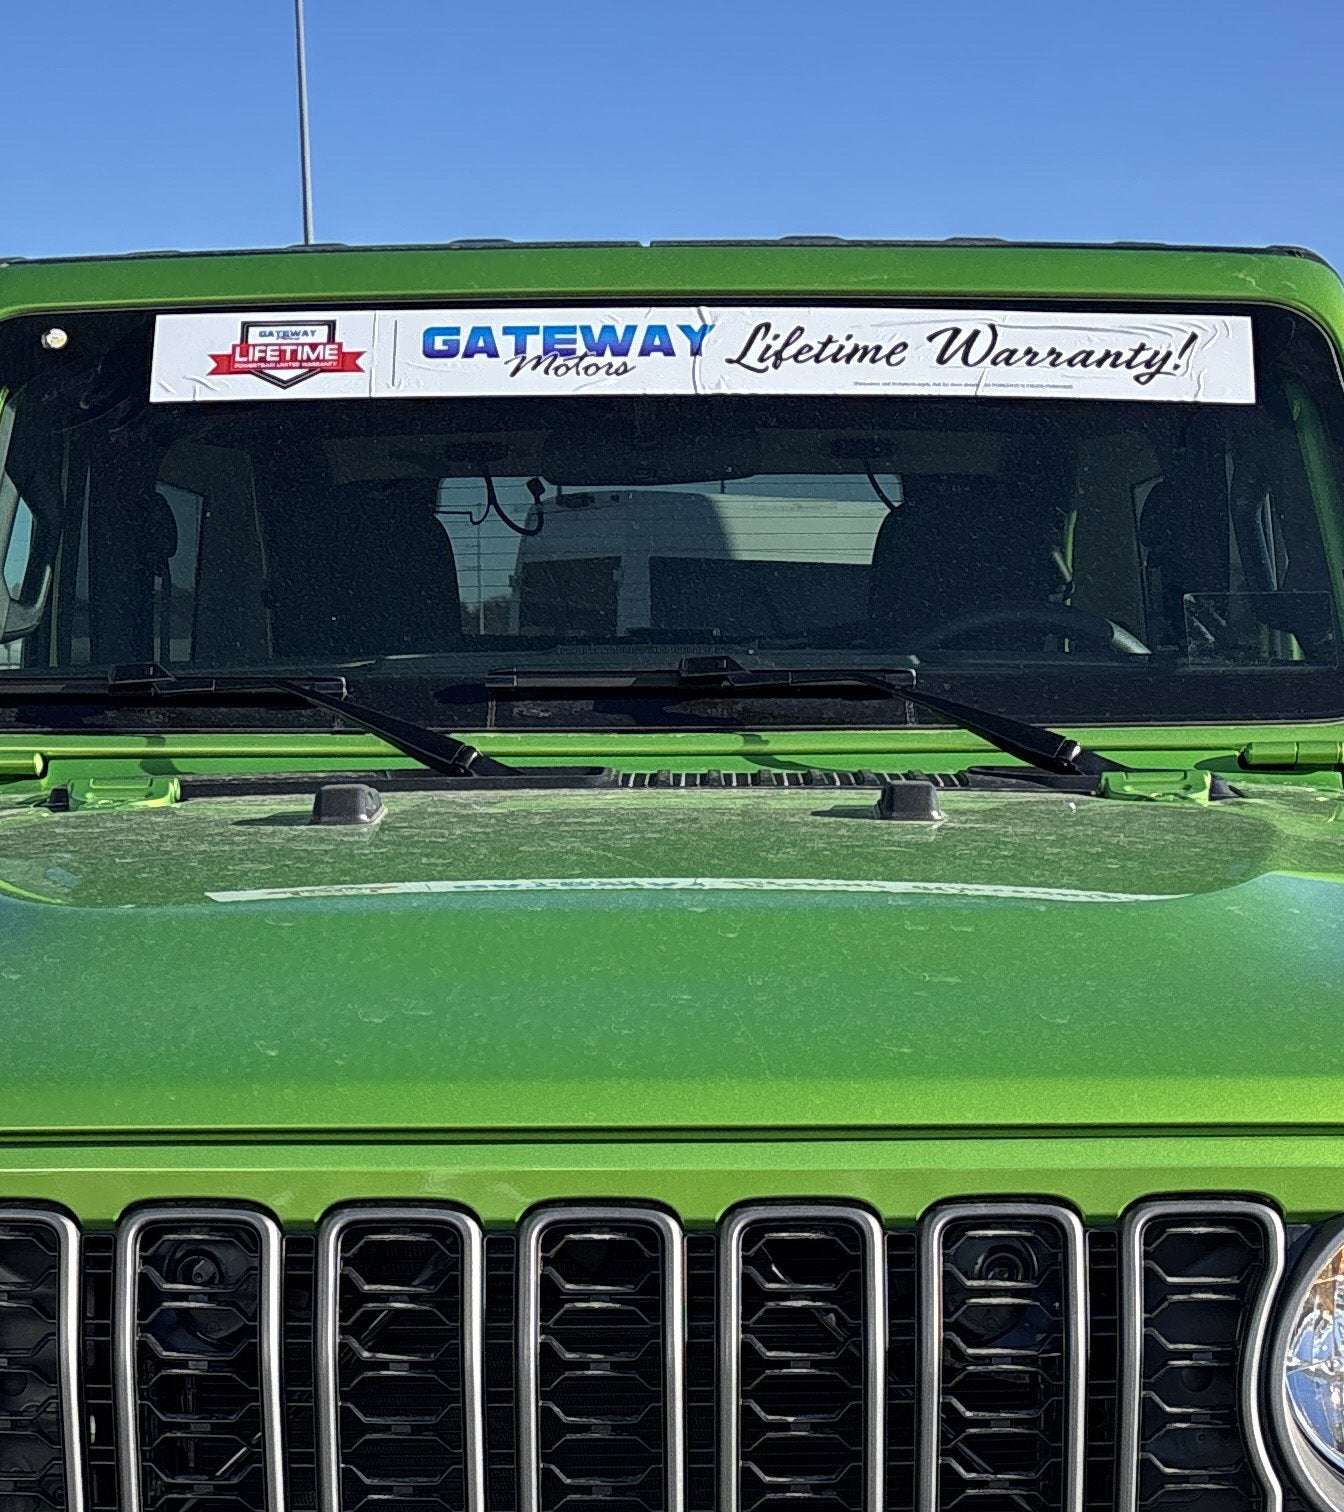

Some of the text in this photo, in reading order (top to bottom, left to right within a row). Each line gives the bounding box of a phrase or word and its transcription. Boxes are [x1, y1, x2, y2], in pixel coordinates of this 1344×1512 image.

[258, 329, 317, 338] GATEWAY
[422, 324, 716, 360] GATEWAY
[234, 344, 339, 362] LIFETIME
[504, 351, 637, 378] Motors
[725, 321, 1198, 386] Lifetime Warranty!
